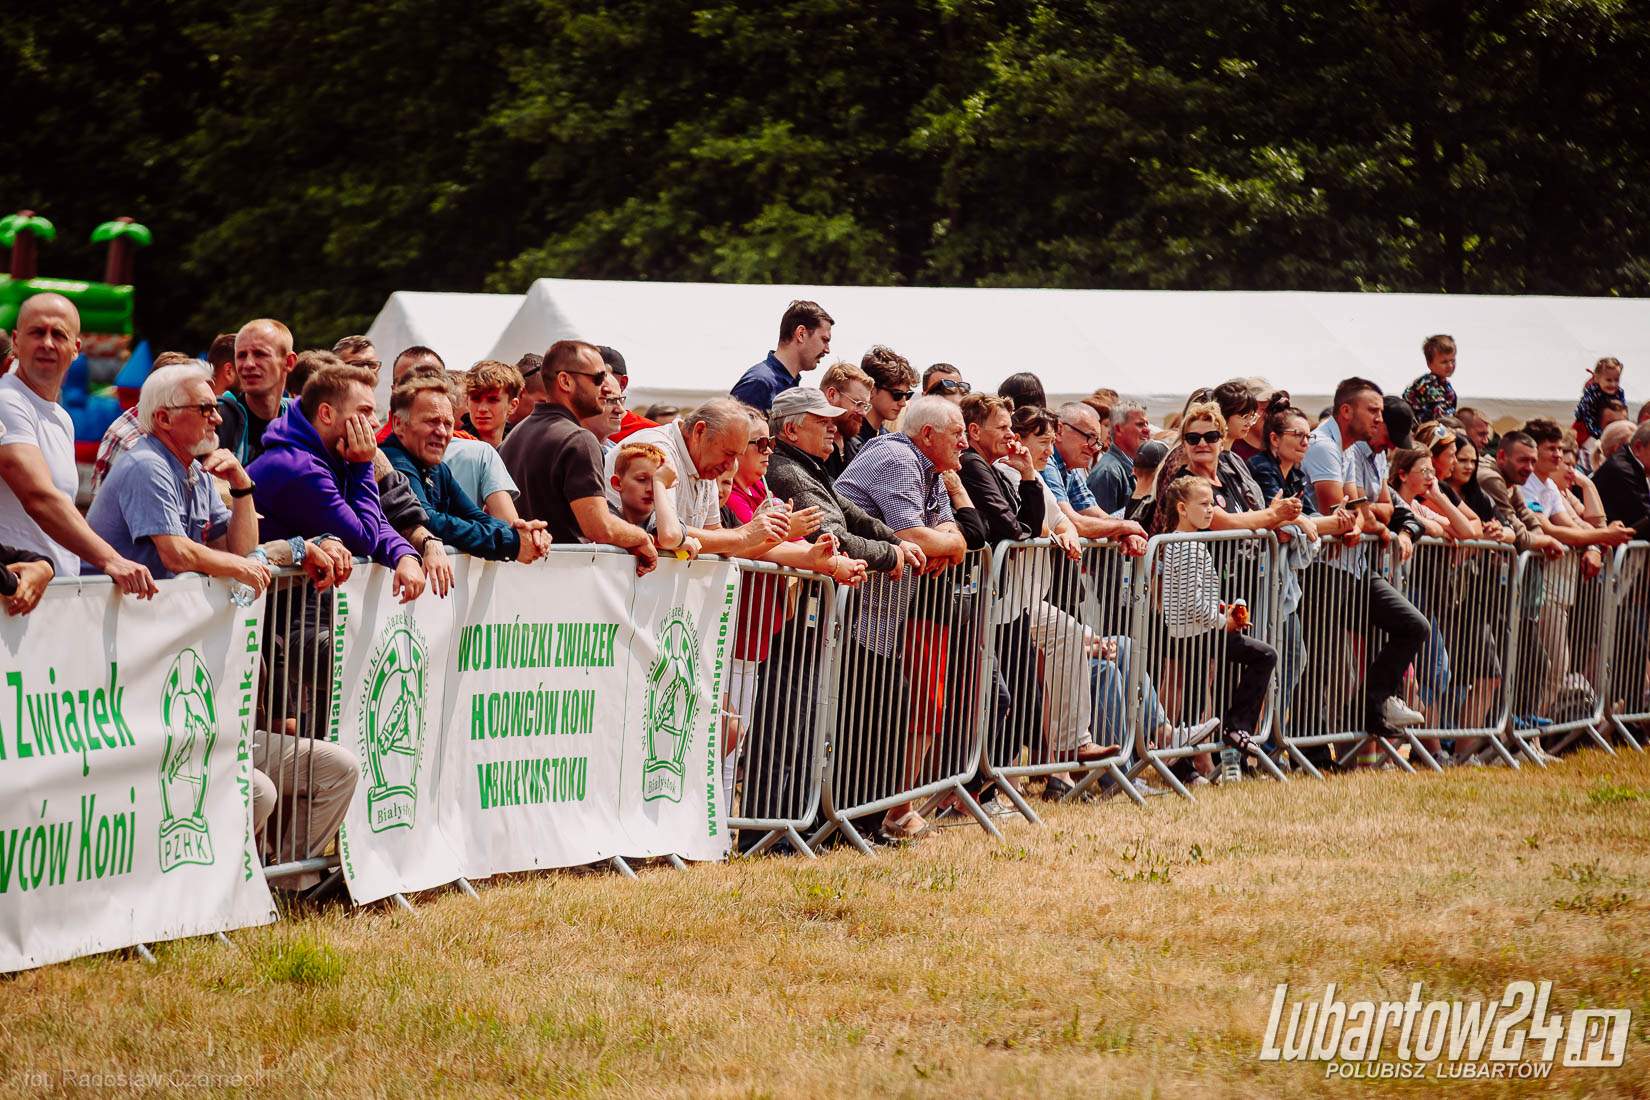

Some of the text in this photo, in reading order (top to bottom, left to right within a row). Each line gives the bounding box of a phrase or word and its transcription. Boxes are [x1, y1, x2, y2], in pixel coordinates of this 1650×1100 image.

[554, 623, 619, 675] ZWIĄZEK
[6, 661, 137, 776] Związek
[560, 688, 596, 735] KONI
[77, 786, 137, 880] Koni
[164, 832, 209, 866] PZHK
